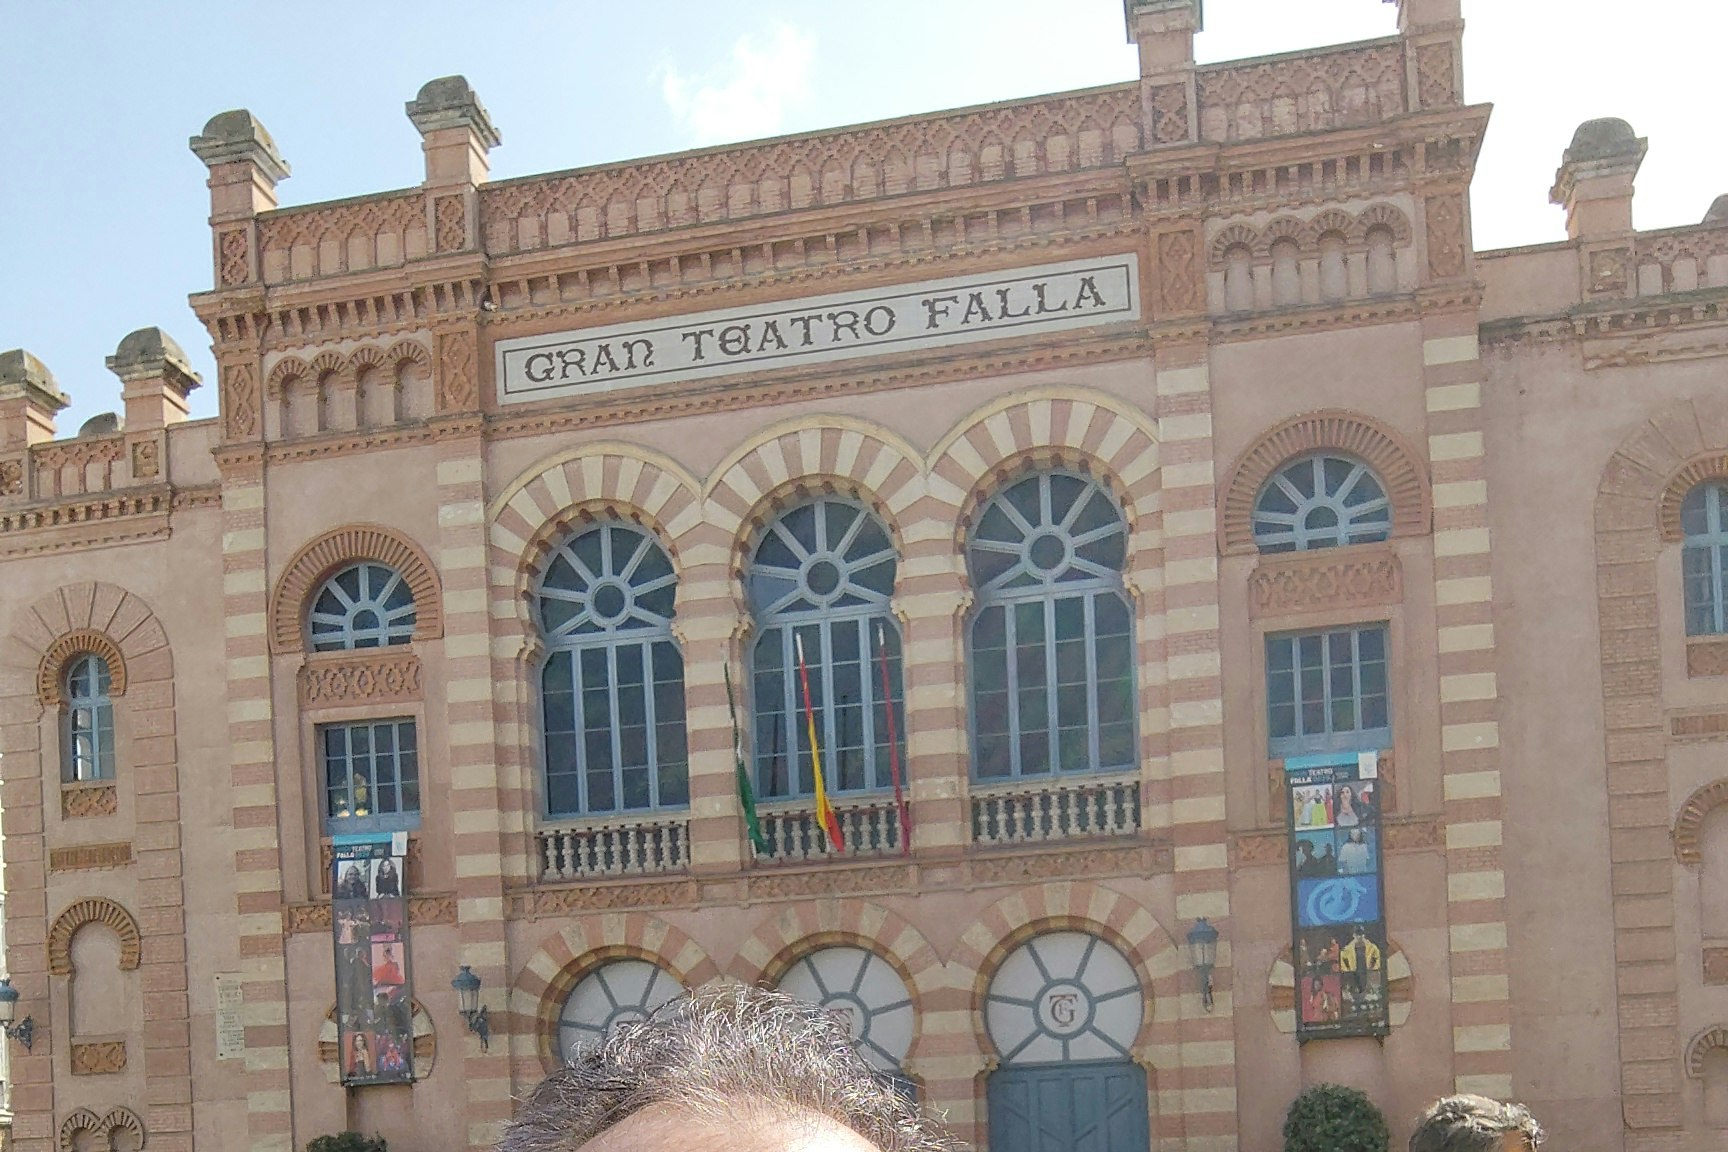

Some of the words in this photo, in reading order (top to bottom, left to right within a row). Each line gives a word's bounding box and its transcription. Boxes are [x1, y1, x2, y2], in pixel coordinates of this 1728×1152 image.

[524, 336, 655, 384] GRAN
[681, 305, 897, 361] TEATRO
[921, 276, 1106, 329] FALLA
